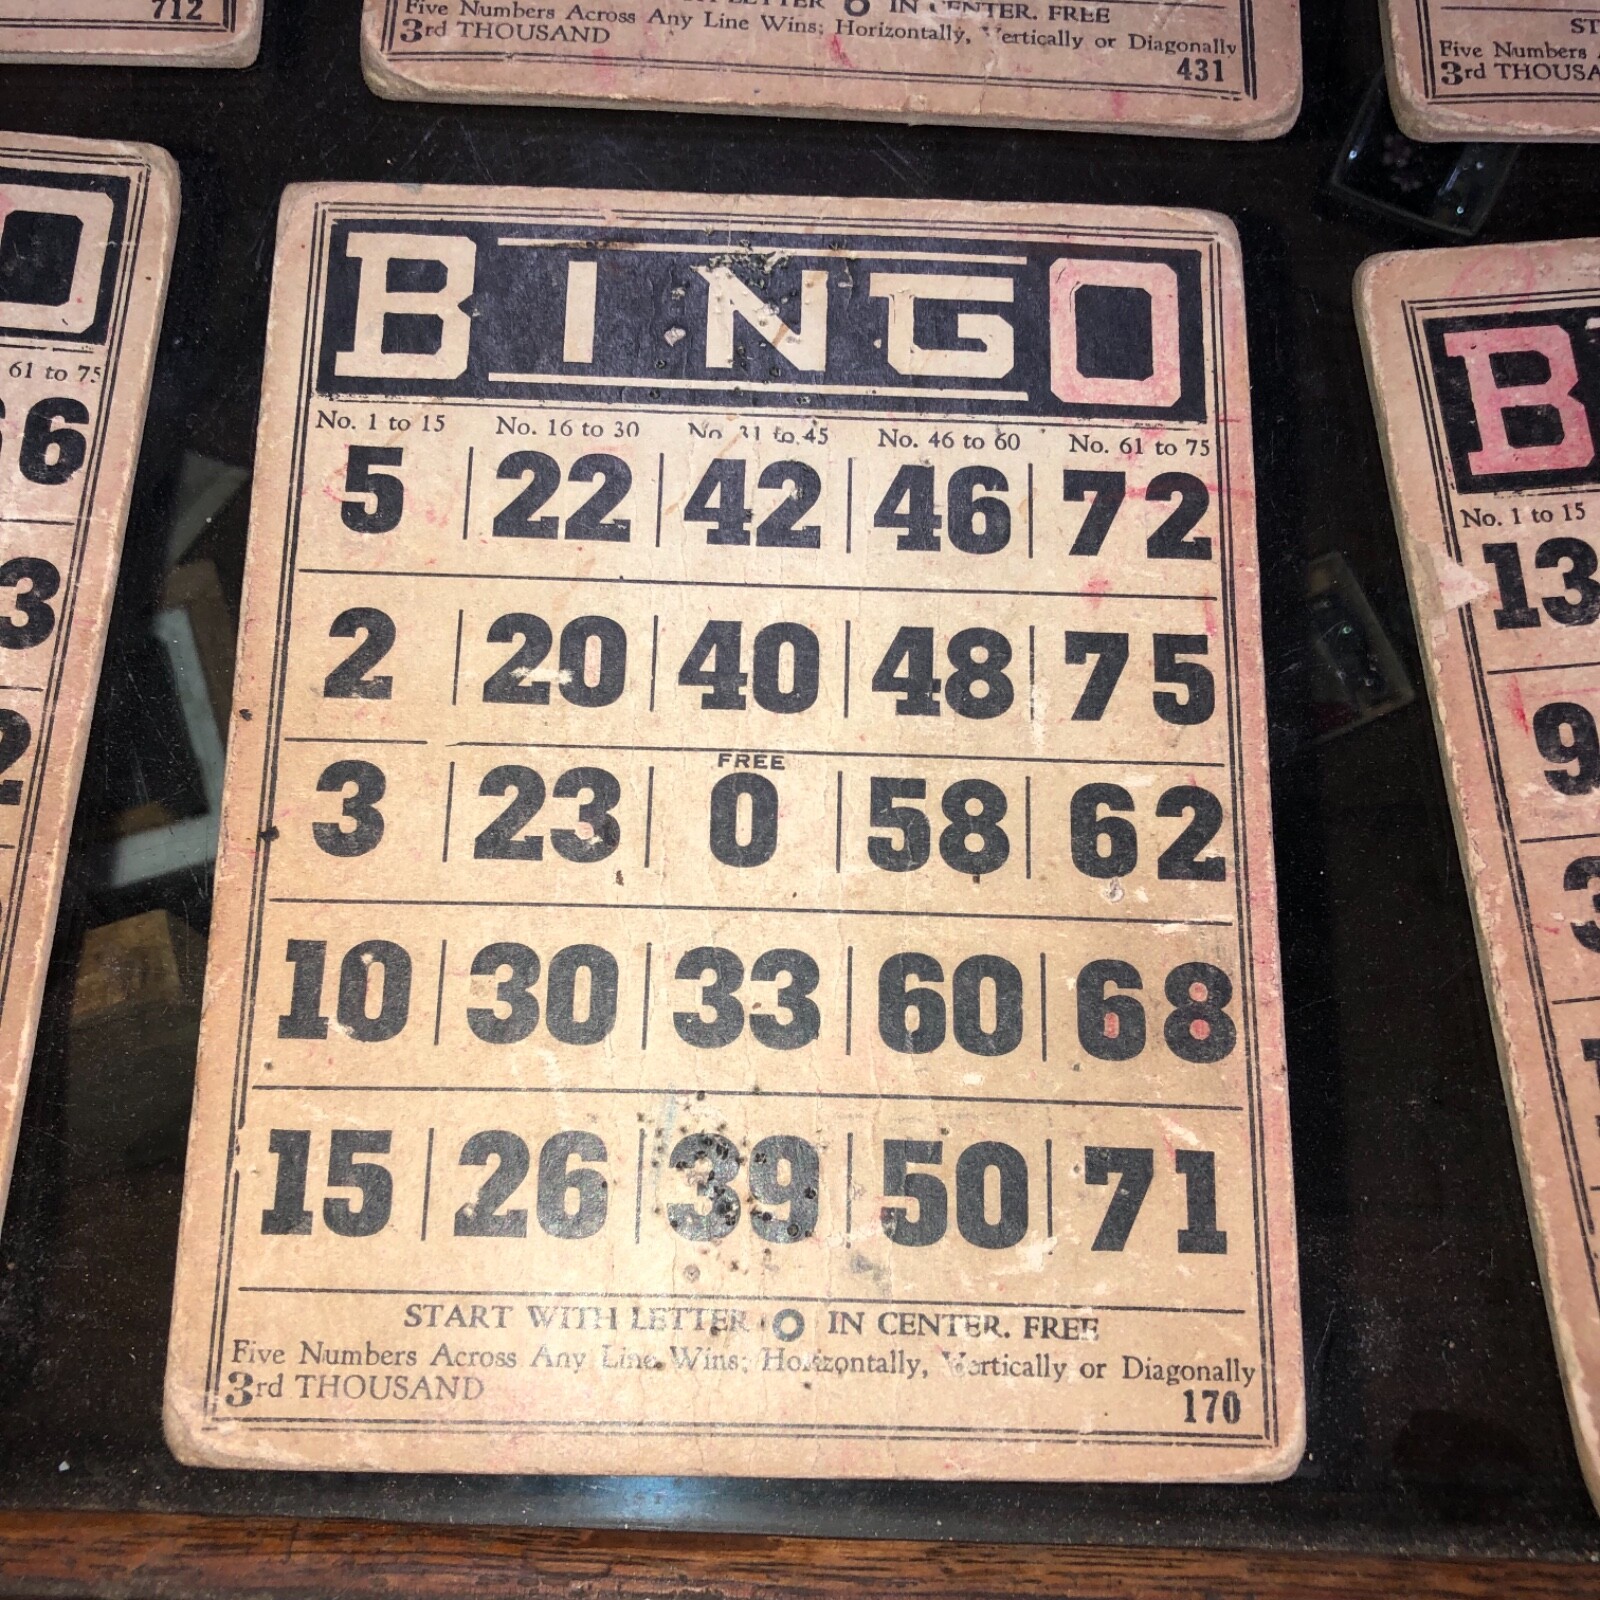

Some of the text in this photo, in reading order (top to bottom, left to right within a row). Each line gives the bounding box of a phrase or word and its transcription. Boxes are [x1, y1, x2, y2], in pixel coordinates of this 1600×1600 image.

[152, 0, 203, 20] 712
[889, 0, 918, 14] IN
[1049, 5, 1111, 24] FREE
[399, 18, 611, 44] 3rd THOUSAND
[405, 0, 449, 15] Five
[459, 0, 555, 19] Numbers
[565, 4, 636, 23] Across
[647, 8, 693, 29] Any
[704, 11, 749, 31] Line
[761, 14, 824, 36] Wins;
[835, 18, 972, 45] Horizontally,
[1095, 37, 1116, 49] or
[1128, 33, 1237, 59] Diagonally
[1439, 40, 1588, 60] Five Numbers
[1176, 57, 1225, 83] 431
[1441, 60, 1600, 85] 3rd THOUSA
[8, 361, 102, 384] 61 to 75
[315, 410, 446, 433] No. 1 to 15
[495, 416, 641, 439] No. 16 to 30
[801, 427, 829, 446] 45
[877, 428, 1021, 452] No. 46 to 60
[1068, 434, 1211, 458] No. 61 to 75
[341, 445, 1213, 560] 5 22 42 46 72
[1459, 501, 1586, 529] No. 1 to 15
[1482, 537, 1600, 629] 13
[323, 606, 1214, 726] 2 20 40 48 75
[717, 752, 786, 771] FREE
[312, 760, 1226, 881] 3 23 0 58 62
[277, 938, 1237, 1064] 10 30 33 60 68
[261, 1129, 1229, 1255] 15 26 39 50 71
[404, 1303, 1100, 1343] START WITH LETTER O IN CENTER. FREE
[231, 1338, 286, 1365] Five
[298, 1340, 418, 1367] Numbers
[429, 1342, 518, 1369] Across
[529, 1344, 587, 1375] Any
[601, 1344, 658, 1370] Line
[669, 1346, 749, 1375] Wins;
[1079, 1362, 1107, 1379] or
[1122, 1354, 1256, 1386] Diagonally
[224, 1370, 486, 1408] 3rd THOUSAND
[1182, 1388, 1243, 1425] 170
